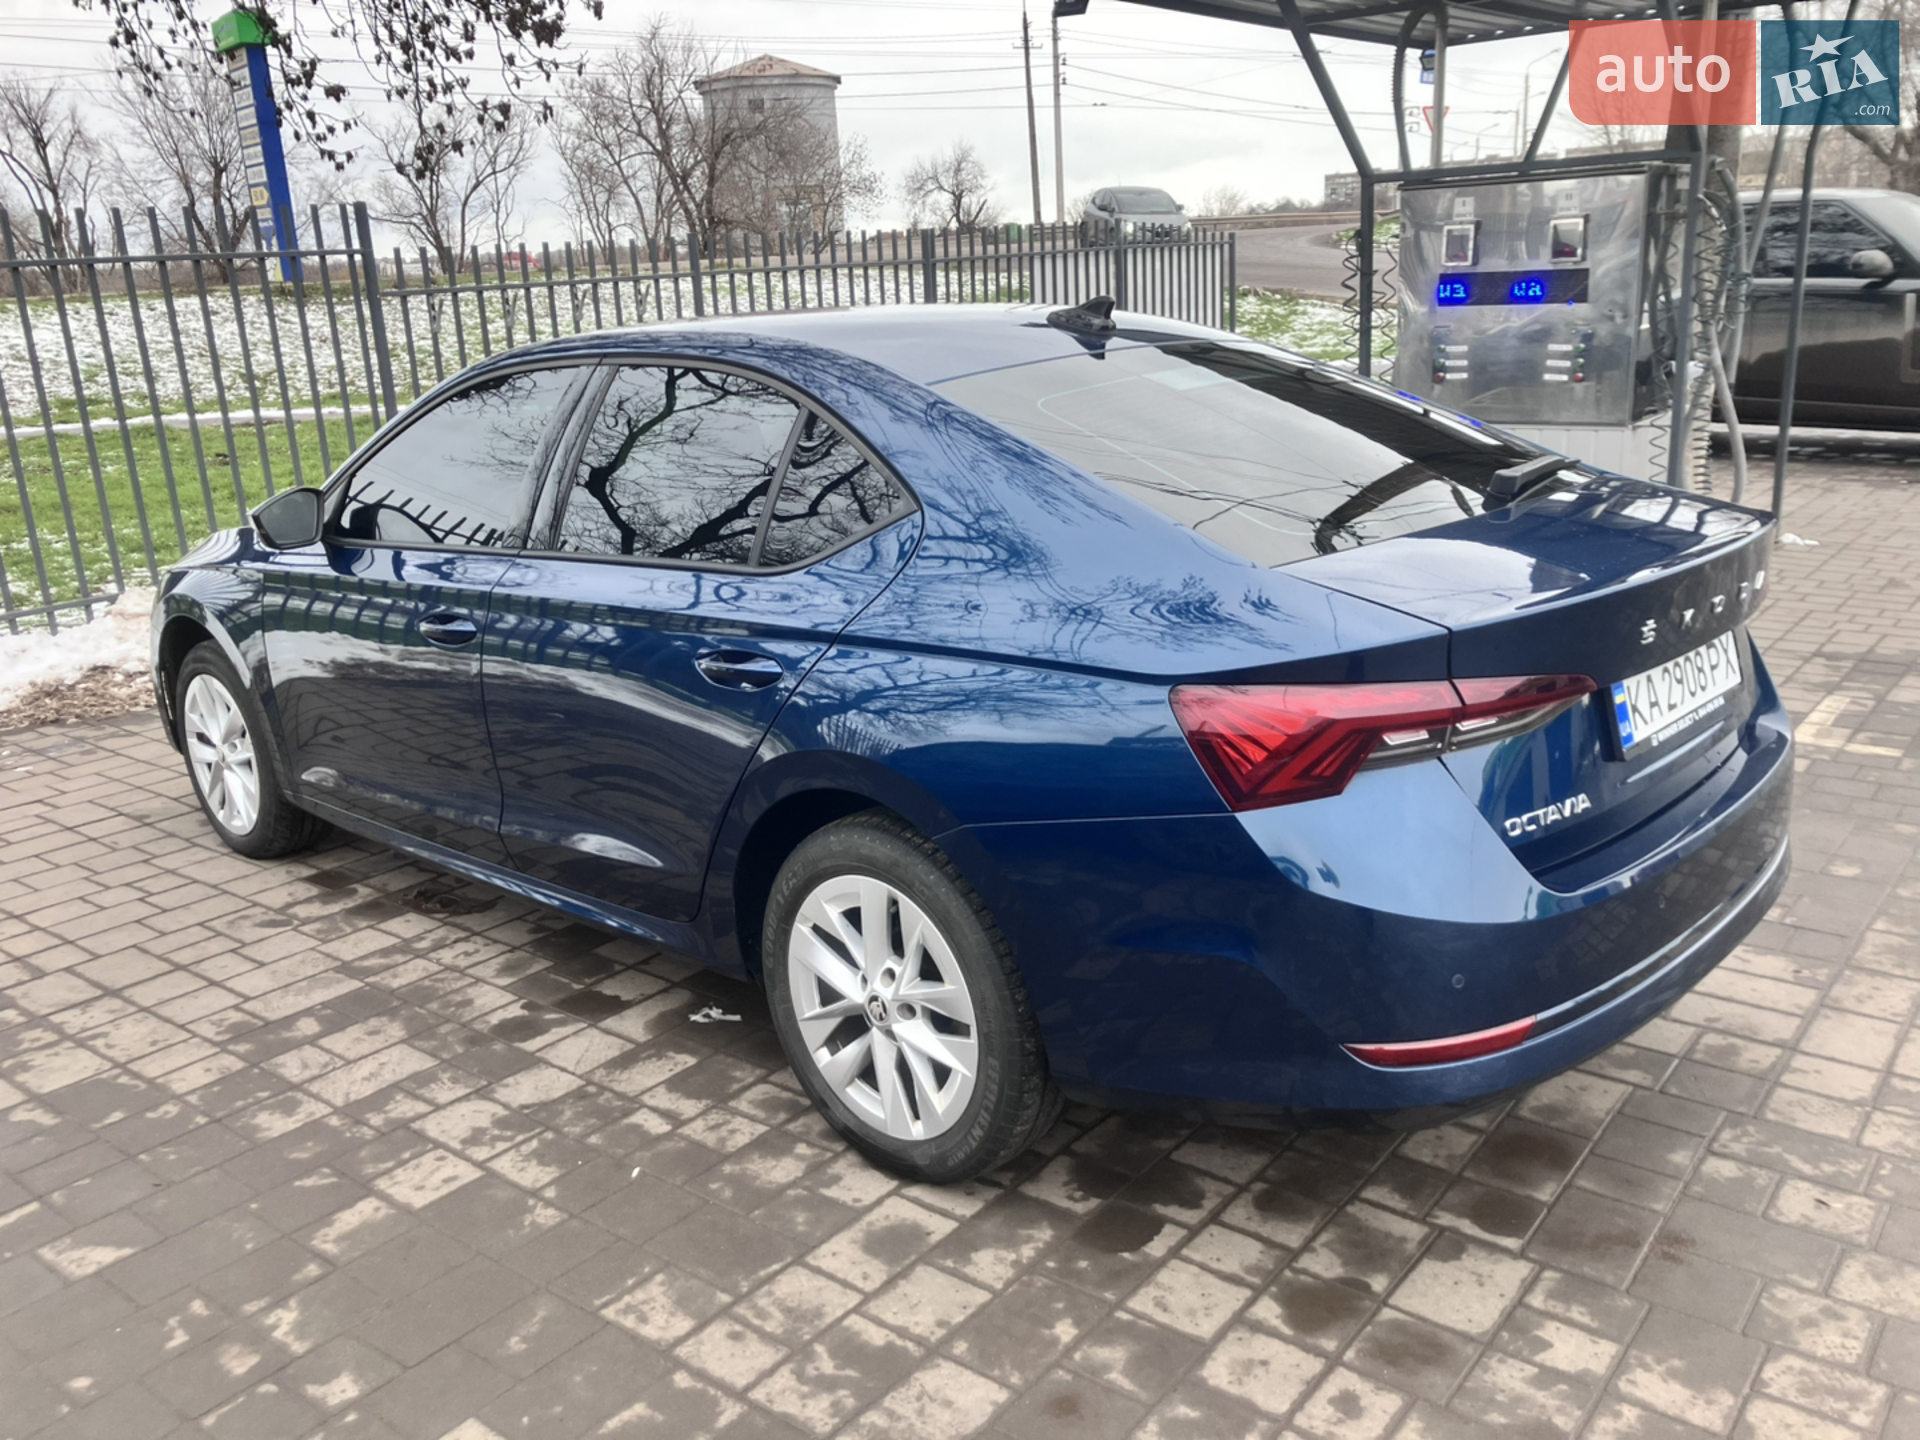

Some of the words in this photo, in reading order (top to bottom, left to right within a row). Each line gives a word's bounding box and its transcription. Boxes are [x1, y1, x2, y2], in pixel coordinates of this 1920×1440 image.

[1661, 649, 1709, 712] 2908
[1504, 792, 1592, 838] OCTAVIA
[967, 1056, 1001, 1149] EFFICIENT
